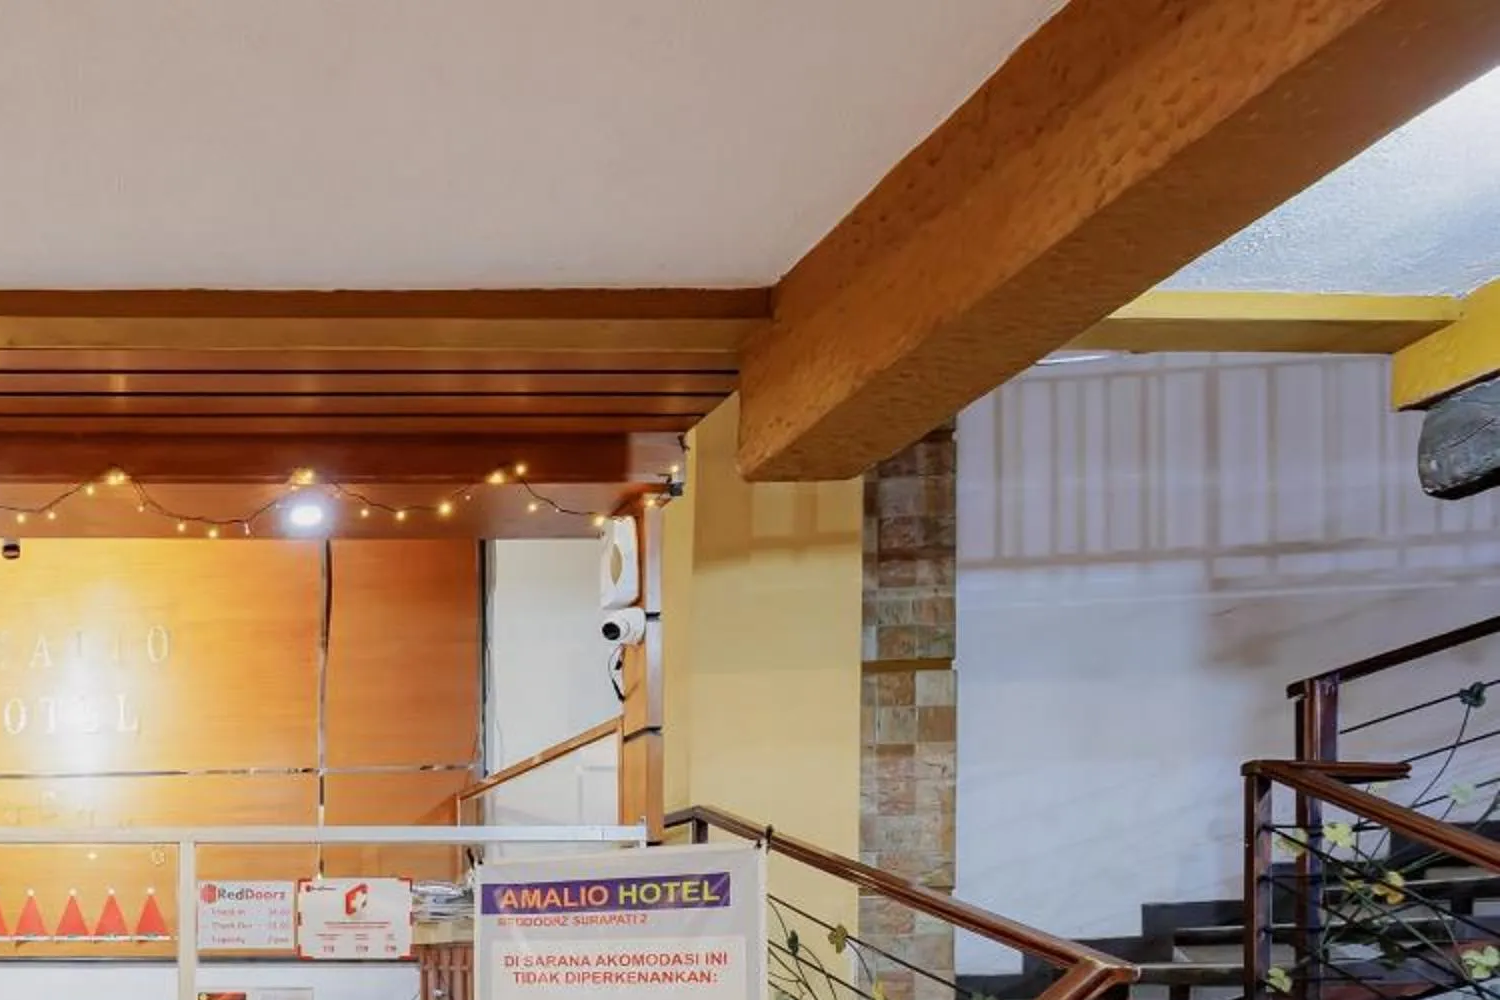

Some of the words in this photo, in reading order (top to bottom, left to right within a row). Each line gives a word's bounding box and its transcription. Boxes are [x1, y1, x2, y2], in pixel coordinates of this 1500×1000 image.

[500, 885, 609, 909] AMALIO
[619, 881, 720, 905] HOTEL
[504, 955, 520, 968] DI
[521, 954, 593, 968] SARANA
[595, 952, 700, 968] AKOMODASI
[705, 952, 728, 966] INI
[512, 971, 560, 985] TIDAK
